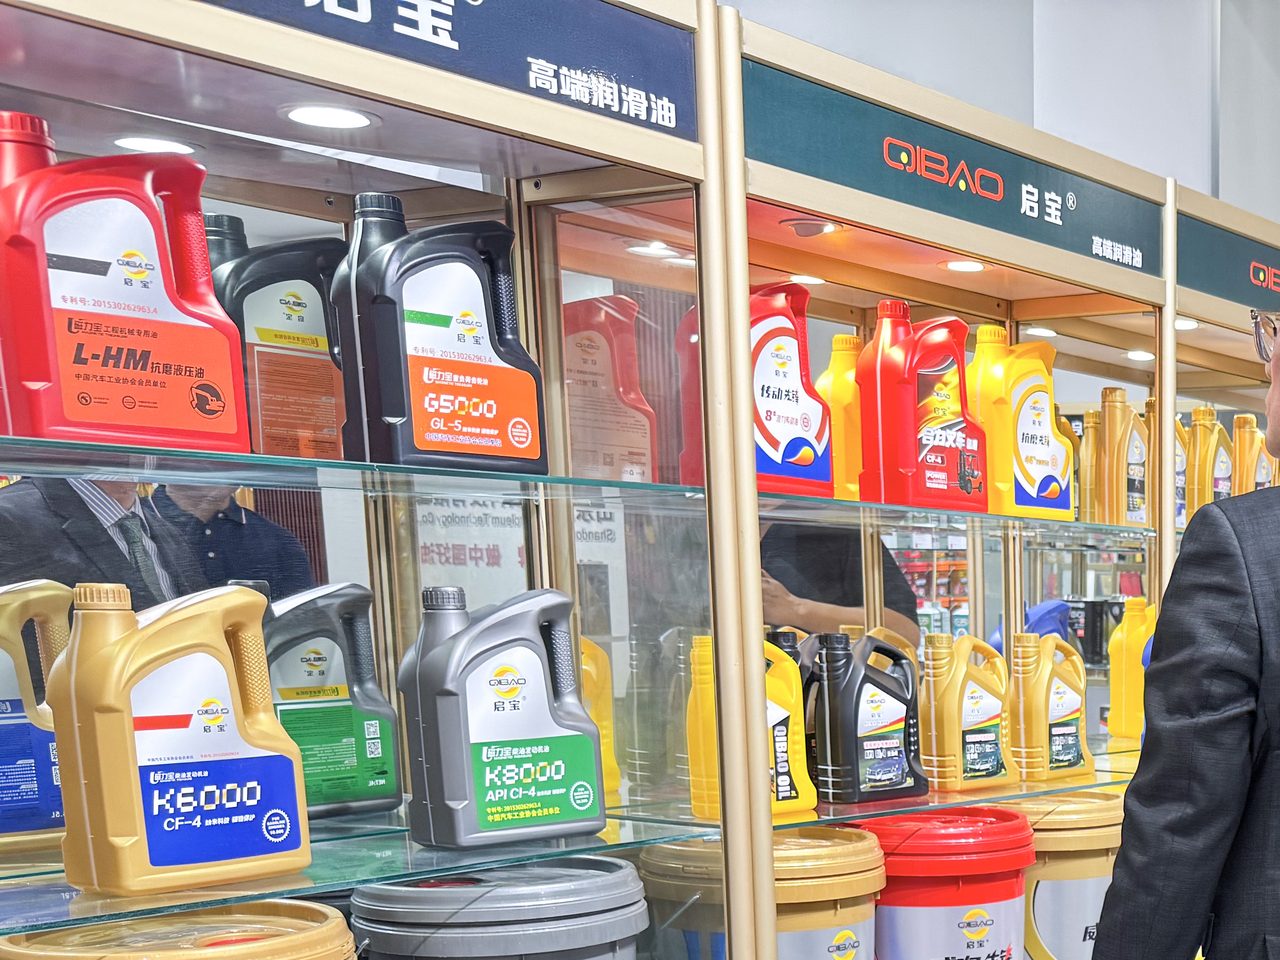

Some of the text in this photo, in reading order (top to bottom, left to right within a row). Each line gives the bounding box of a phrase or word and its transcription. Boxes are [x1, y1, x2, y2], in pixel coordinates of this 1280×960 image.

[527, 56, 677, 128] 高端润滑油
[883, 136, 1004, 202] QIBAO
[1091, 235, 1143, 268] 高端润滑油
[73, 343, 204, 379] L-HM 抗磨液压油
[75, 373, 167, 389] 中国汽车工业协会会员单位
[424, 392, 497, 418] G5000
[430, 417, 462, 431] GL-5
[489, 678, 526, 687] QIBAO
[494, 700, 520, 712] 启宝
[774, 725, 791, 800] QIBAO OIL
[485, 760, 565, 787] K8000
[153, 781, 261, 815] K6000
[485, 789, 507, 802] API
[163, 815, 202, 831] CF-4
[957, 919, 994, 929] QIBAO
[827, 940, 860, 953] QIBAO
